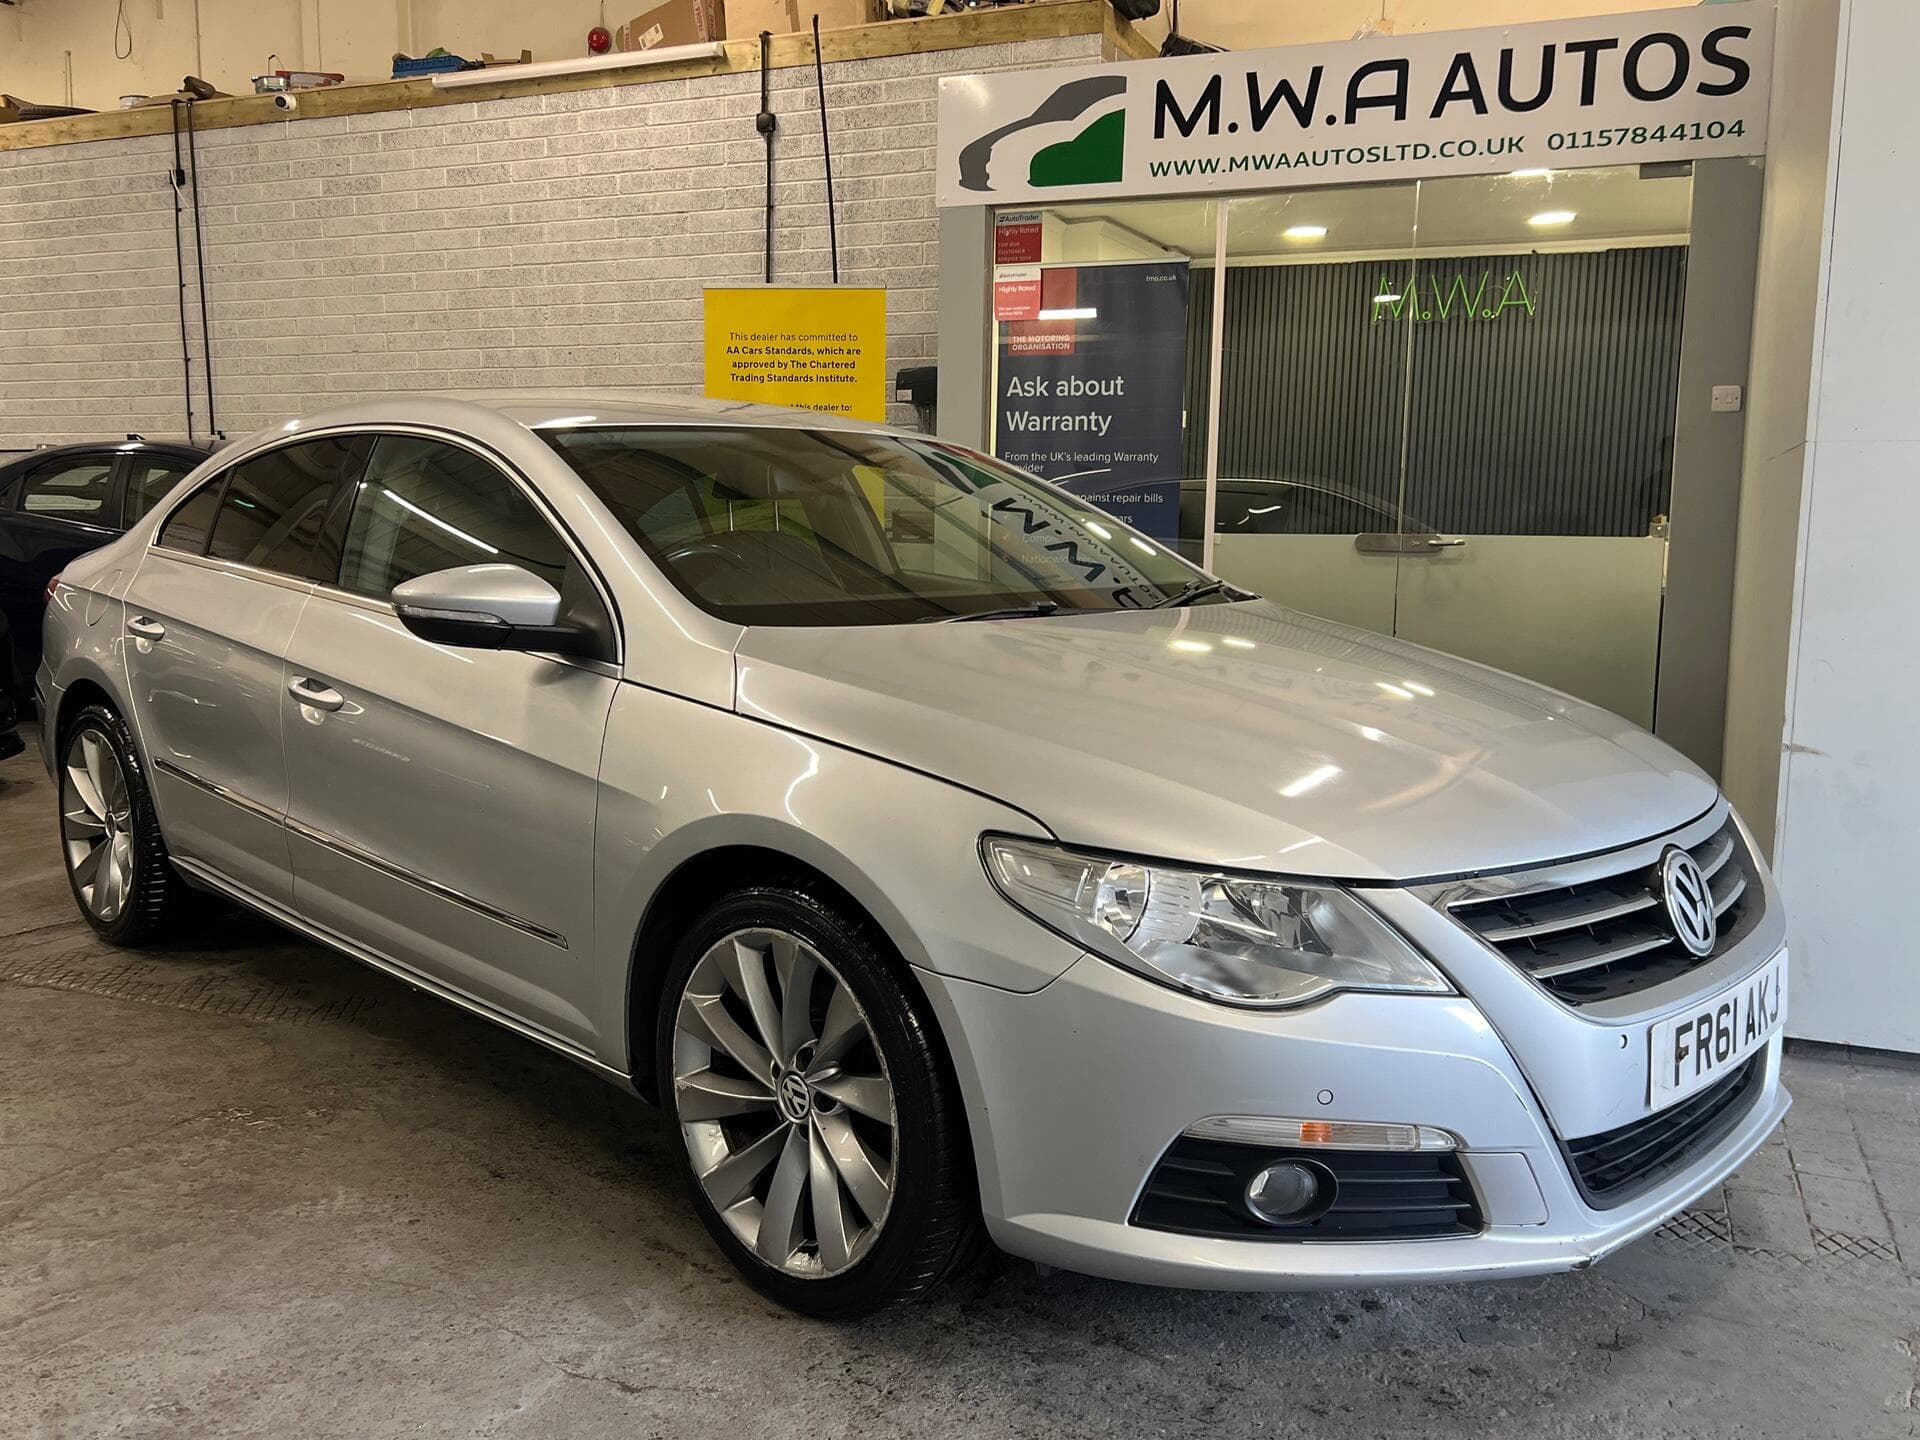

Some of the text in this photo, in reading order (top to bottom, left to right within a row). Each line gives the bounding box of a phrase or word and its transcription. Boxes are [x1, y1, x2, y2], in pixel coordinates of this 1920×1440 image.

[1153, 26, 1752, 140] M.W.A AUTOS
[1149, 119, 1746, 178] WWW.MWAAUTOSLTD.CO.UK 01157844104
[1019, 226, 1039, 234] Rated
[1145, 274, 1177, 282] tmo.co.uk
[998, 284, 1037, 294] Highly Rated
[1373, 270, 1534, 322] M.W.A
[729, 332, 858, 342] This dealer has committed to
[1011, 333, 1071, 343] THE MOTORING
[726, 346, 862, 356] AA Cars Standards, which are
[1011, 341, 1071, 352] ORGANISATION
[731, 360, 856, 371] approved by The Chartered
[730, 373, 858, 384] Trading Standards Institute.
[1006, 375, 1125, 397] Ask about
[812, 403, 839, 411] dealer
[840, 403, 853, 411] to:
[1006, 410, 1113, 437] Warranty
[1004, 451, 1160, 464] From the UK's leading Warranty
[1112, 494, 1141, 504] repair
[1143, 493, 1164, 503] bills
[1674, 965, 1781, 1087] FR61 AKJ
